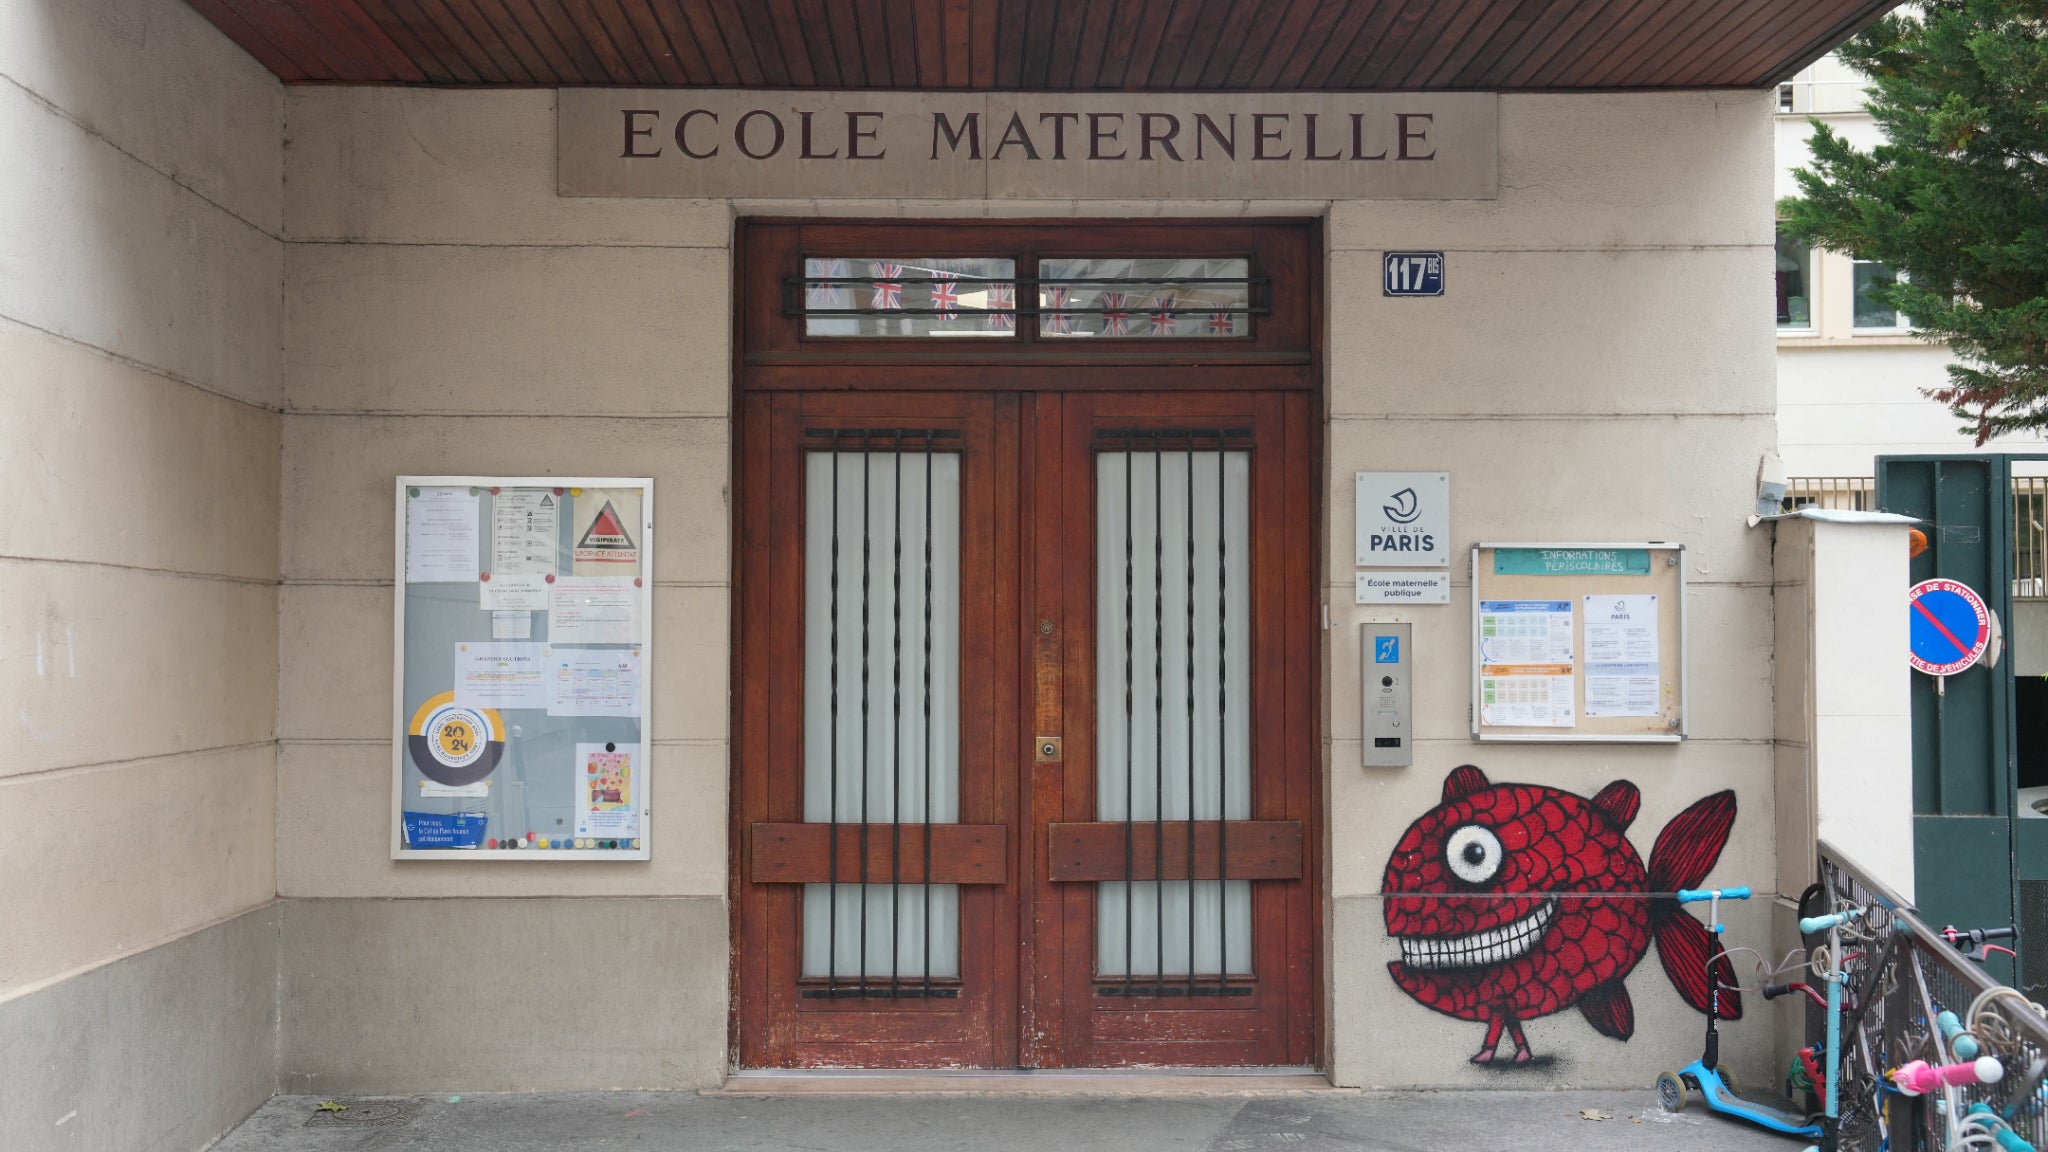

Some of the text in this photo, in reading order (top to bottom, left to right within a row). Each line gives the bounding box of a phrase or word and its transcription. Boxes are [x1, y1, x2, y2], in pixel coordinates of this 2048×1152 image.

[620, 109, 1437, 162] ECOLE MATERNELLE
[1389, 257, 1439, 290] 117 BIS
[1370, 534, 1435, 552] PARIS
[1541, 550, 1618, 562] INFORMATIONS
[1367, 578, 1438, 587] École maternelle
[1384, 589, 1422, 598] publique
[1926, 583, 1939, 593] DE
[1944, 583, 1986, 626] STATIONNER
[1926, 663, 1939, 673] DE
